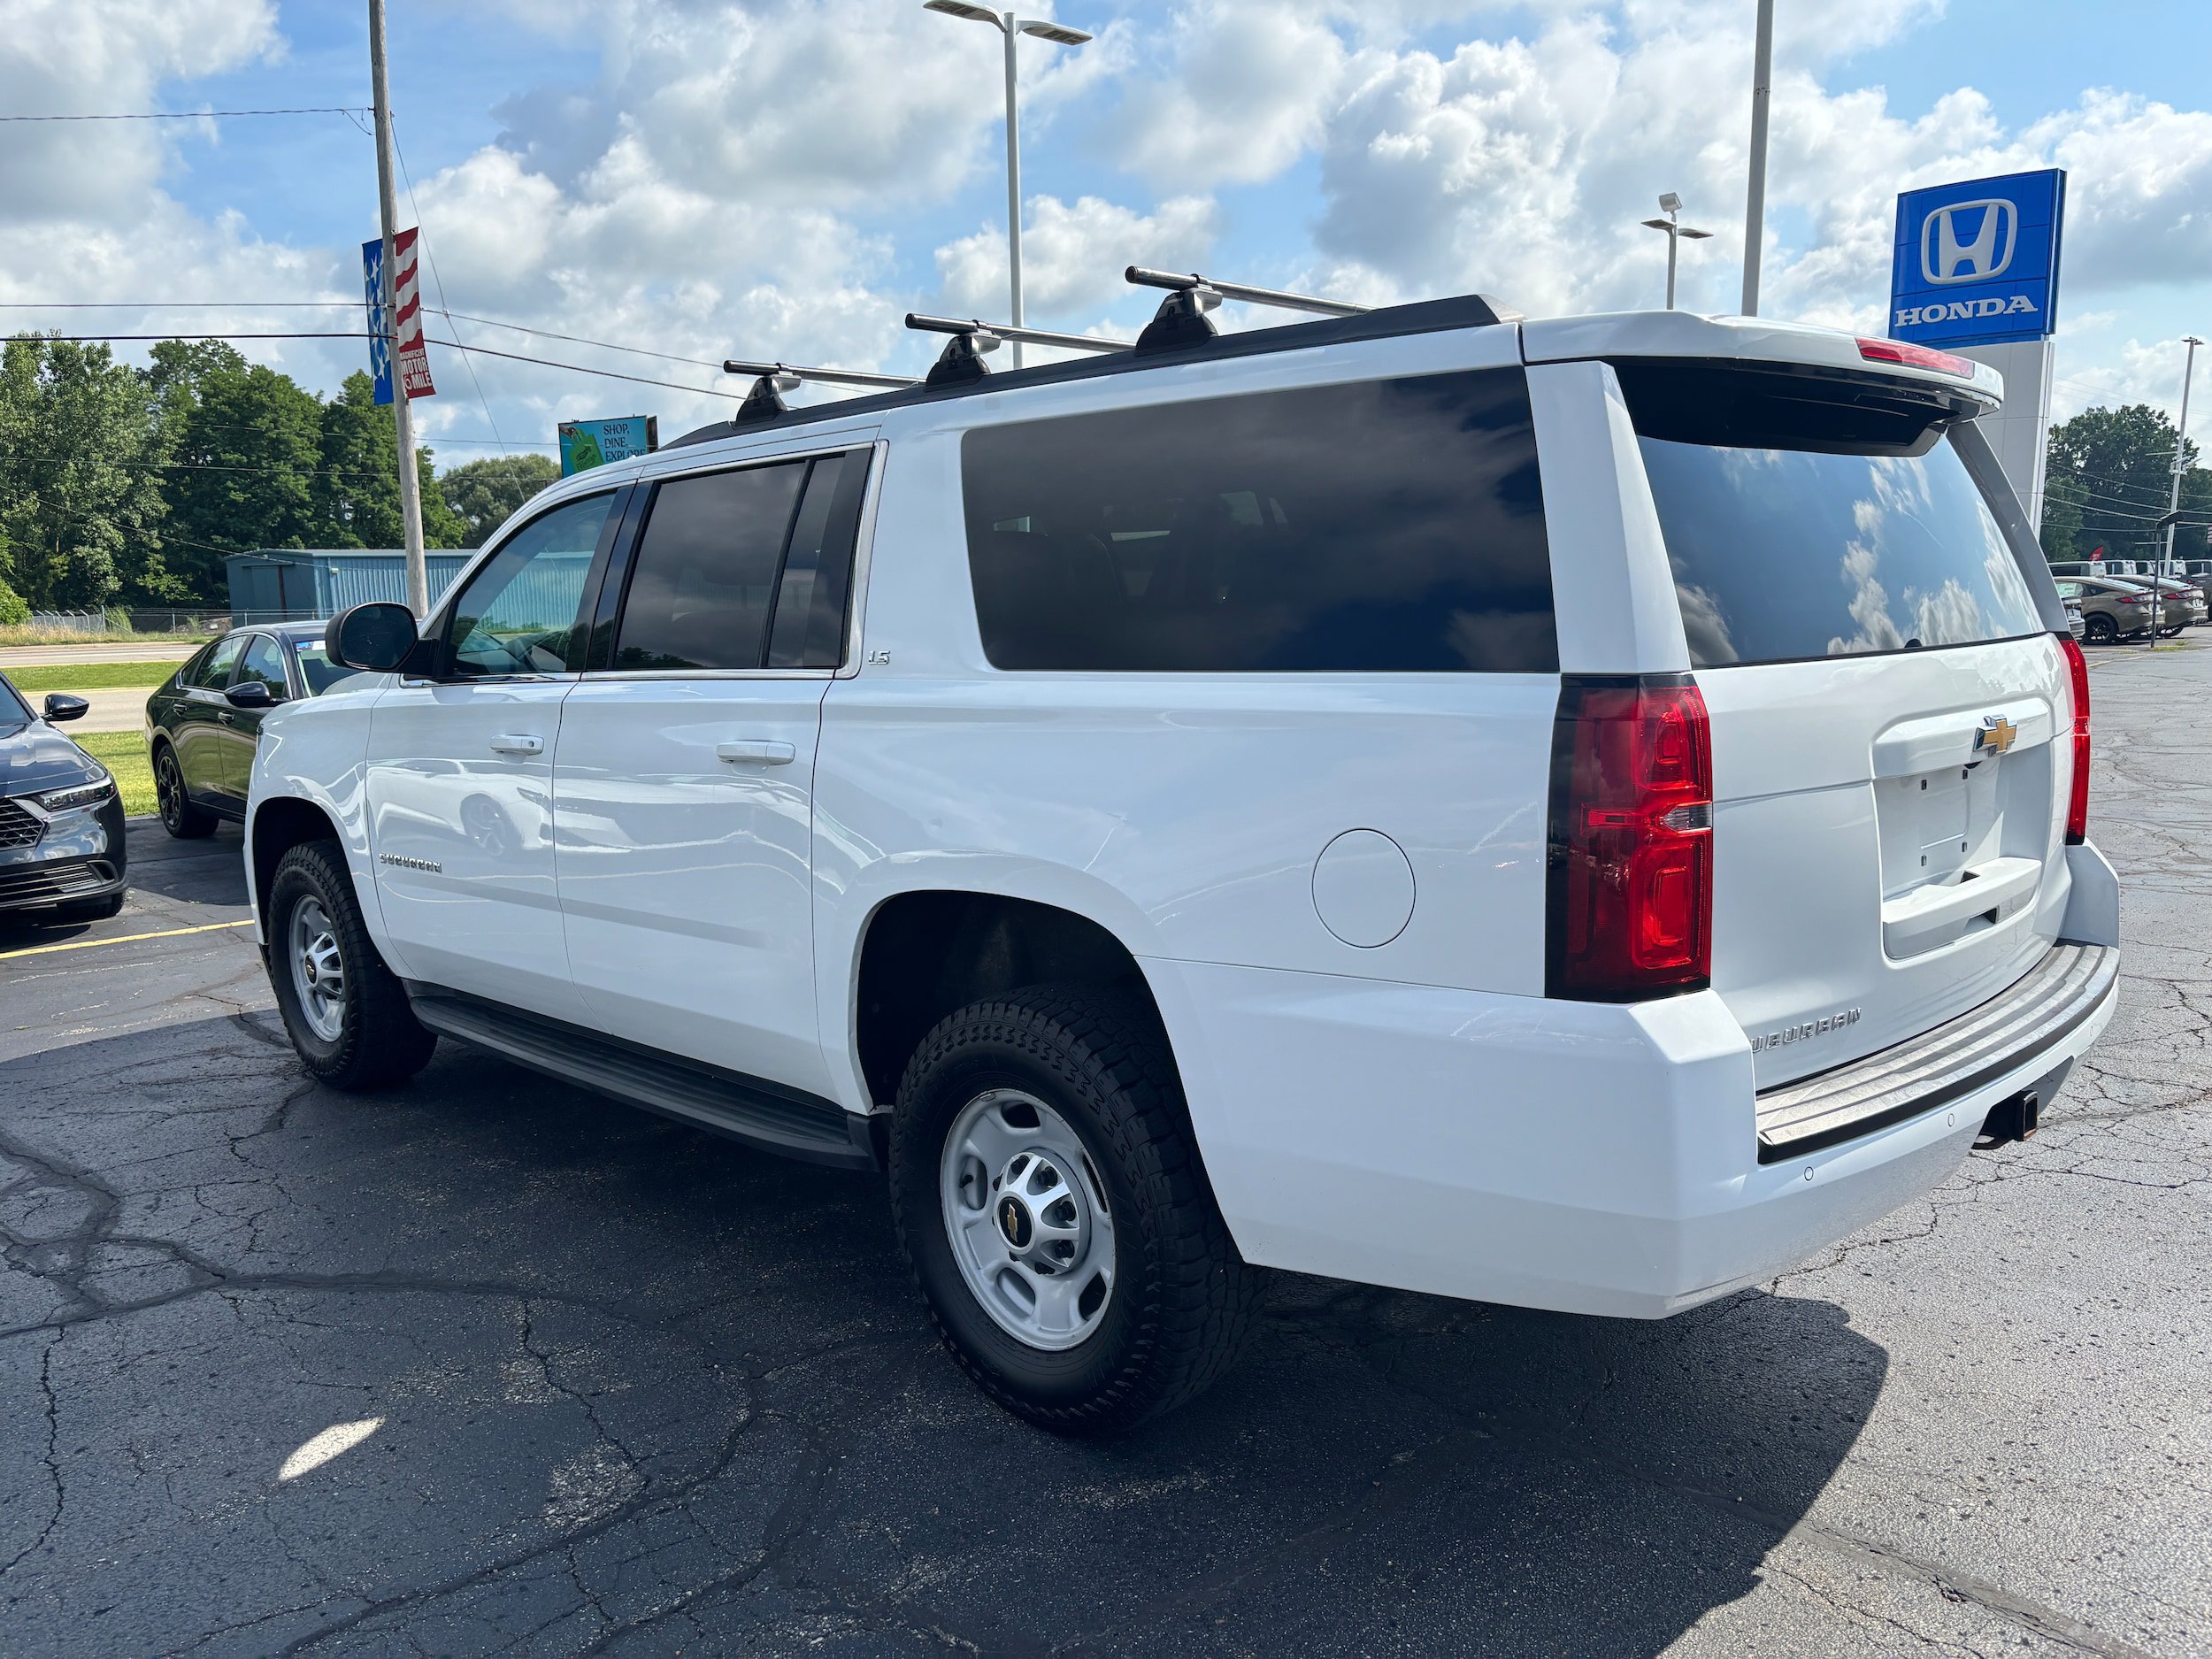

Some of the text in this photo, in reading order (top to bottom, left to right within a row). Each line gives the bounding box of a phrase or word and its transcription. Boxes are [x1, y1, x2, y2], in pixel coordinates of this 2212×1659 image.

[1894, 295, 2039, 327] HONDA
[401, 357, 428, 375] MOTOR
[411, 372, 432, 389] MILE
[603, 424, 630, 435] SHOP,
[604, 437, 628, 449] DINE,
[605, 449, 646, 462] EXPLORE
[868, 650, 891, 665] LS
[379, 853, 442, 873] SUBURBAN
[1750, 1007, 1863, 1053] UBURBAN
